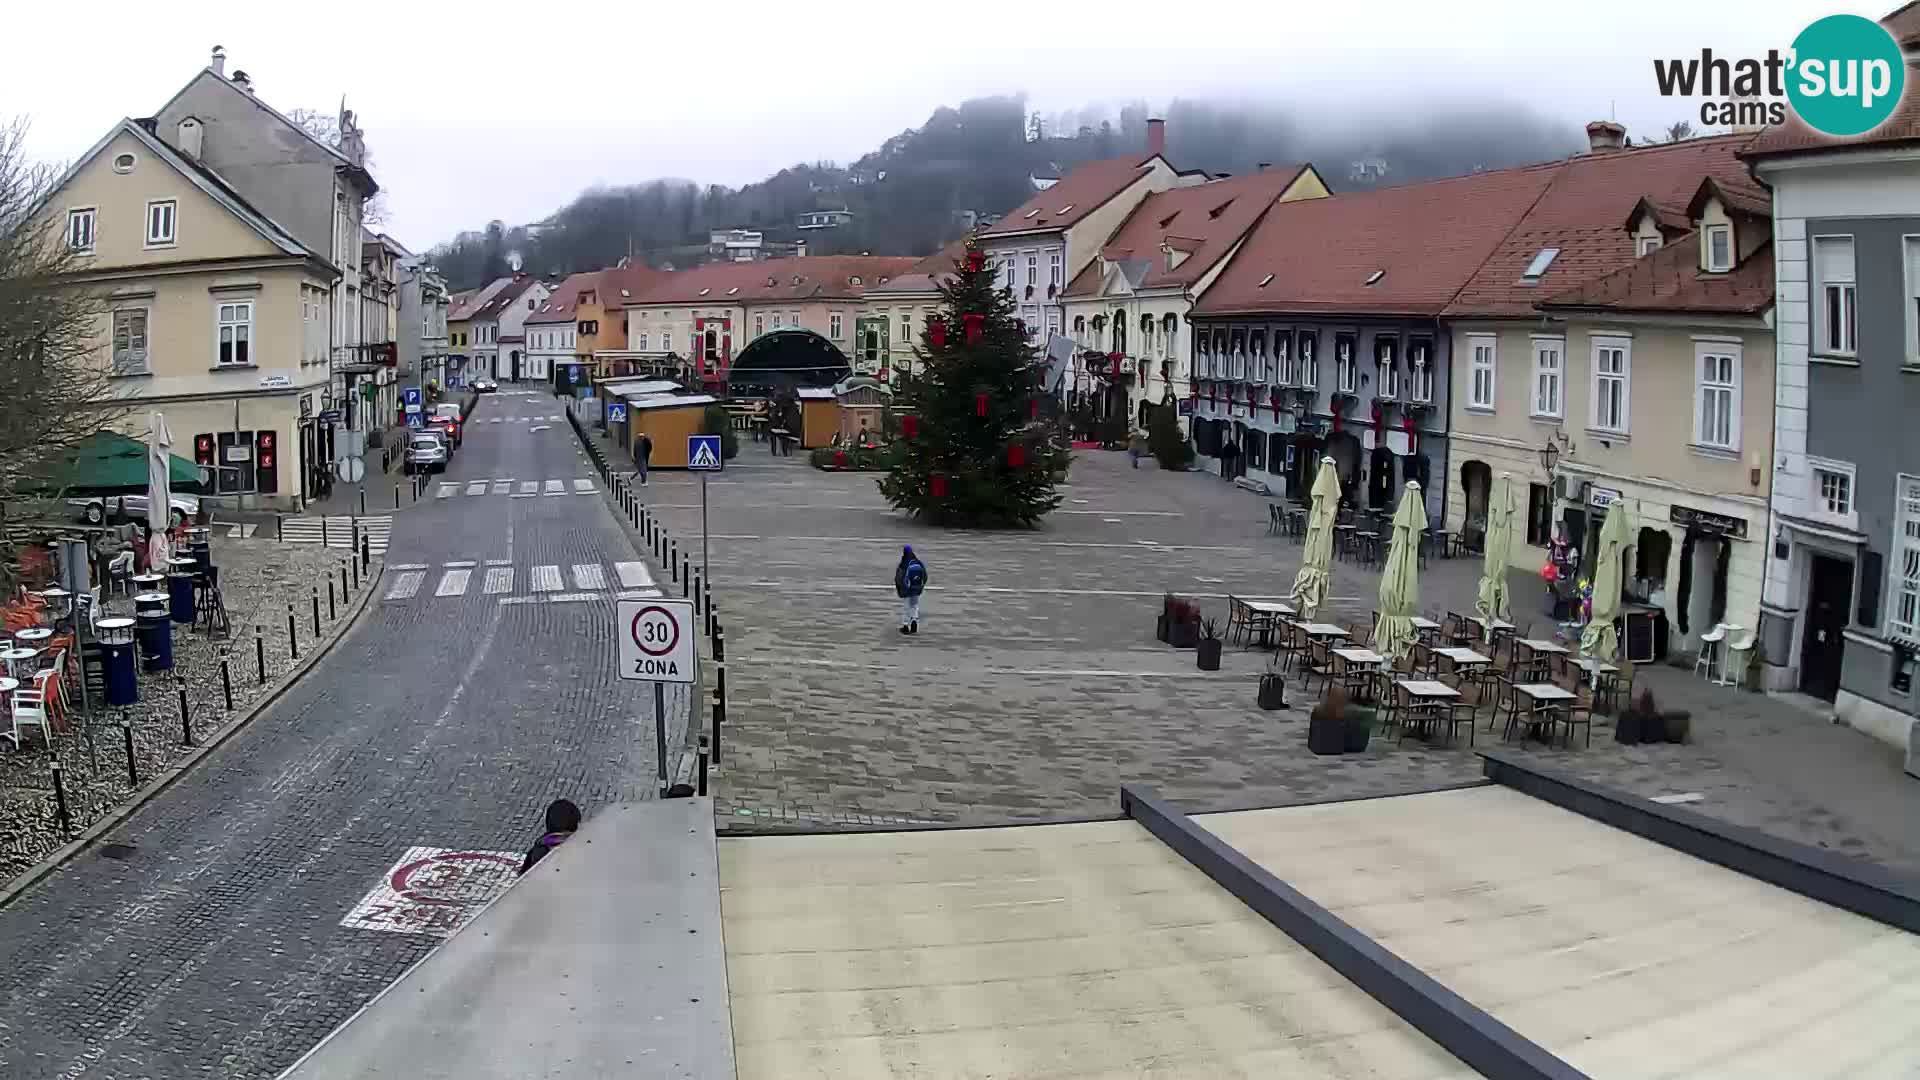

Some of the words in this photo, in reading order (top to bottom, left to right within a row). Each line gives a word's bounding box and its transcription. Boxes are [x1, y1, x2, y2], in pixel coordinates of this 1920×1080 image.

[409, 391, 417, 402] P
[644, 621, 668, 643] 30
[634, 658, 679, 676] ZONA
